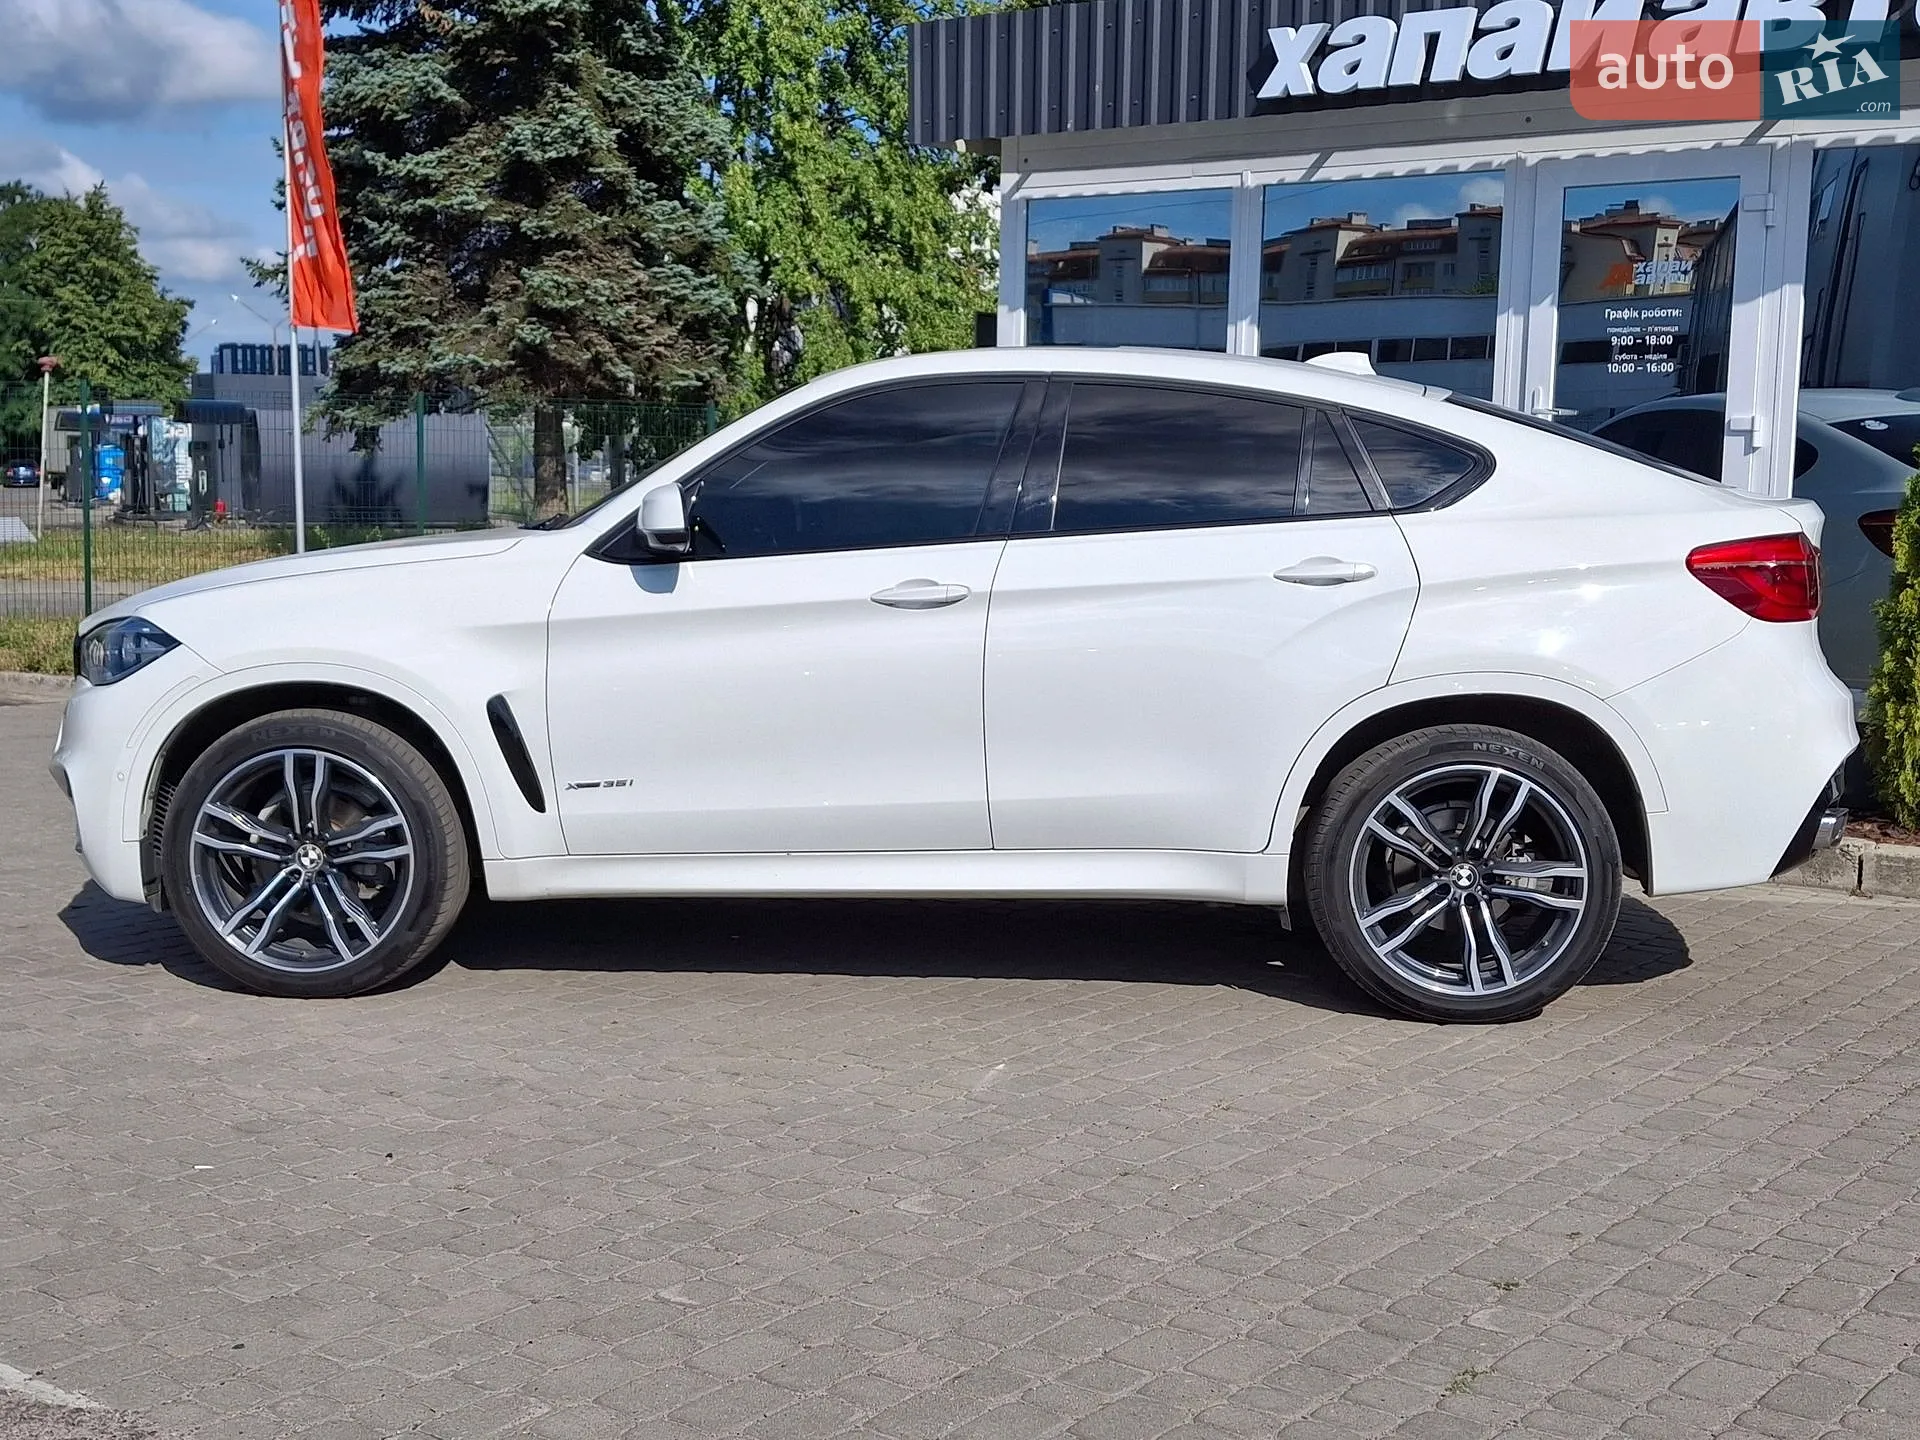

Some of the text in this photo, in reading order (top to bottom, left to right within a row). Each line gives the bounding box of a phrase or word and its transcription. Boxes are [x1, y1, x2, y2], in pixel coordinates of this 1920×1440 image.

[1605, 307, 1683, 320] Графік роботи:
[1611, 335, 1634, 346] 9:00
[1645, 334, 1673, 345] 18:00
[1614, 353, 1638, 361] субота
[1607, 363, 1635, 373] 10:00
[1646, 362, 1674, 373] 16:00
[1473, 742, 1545, 770] NEXEN
